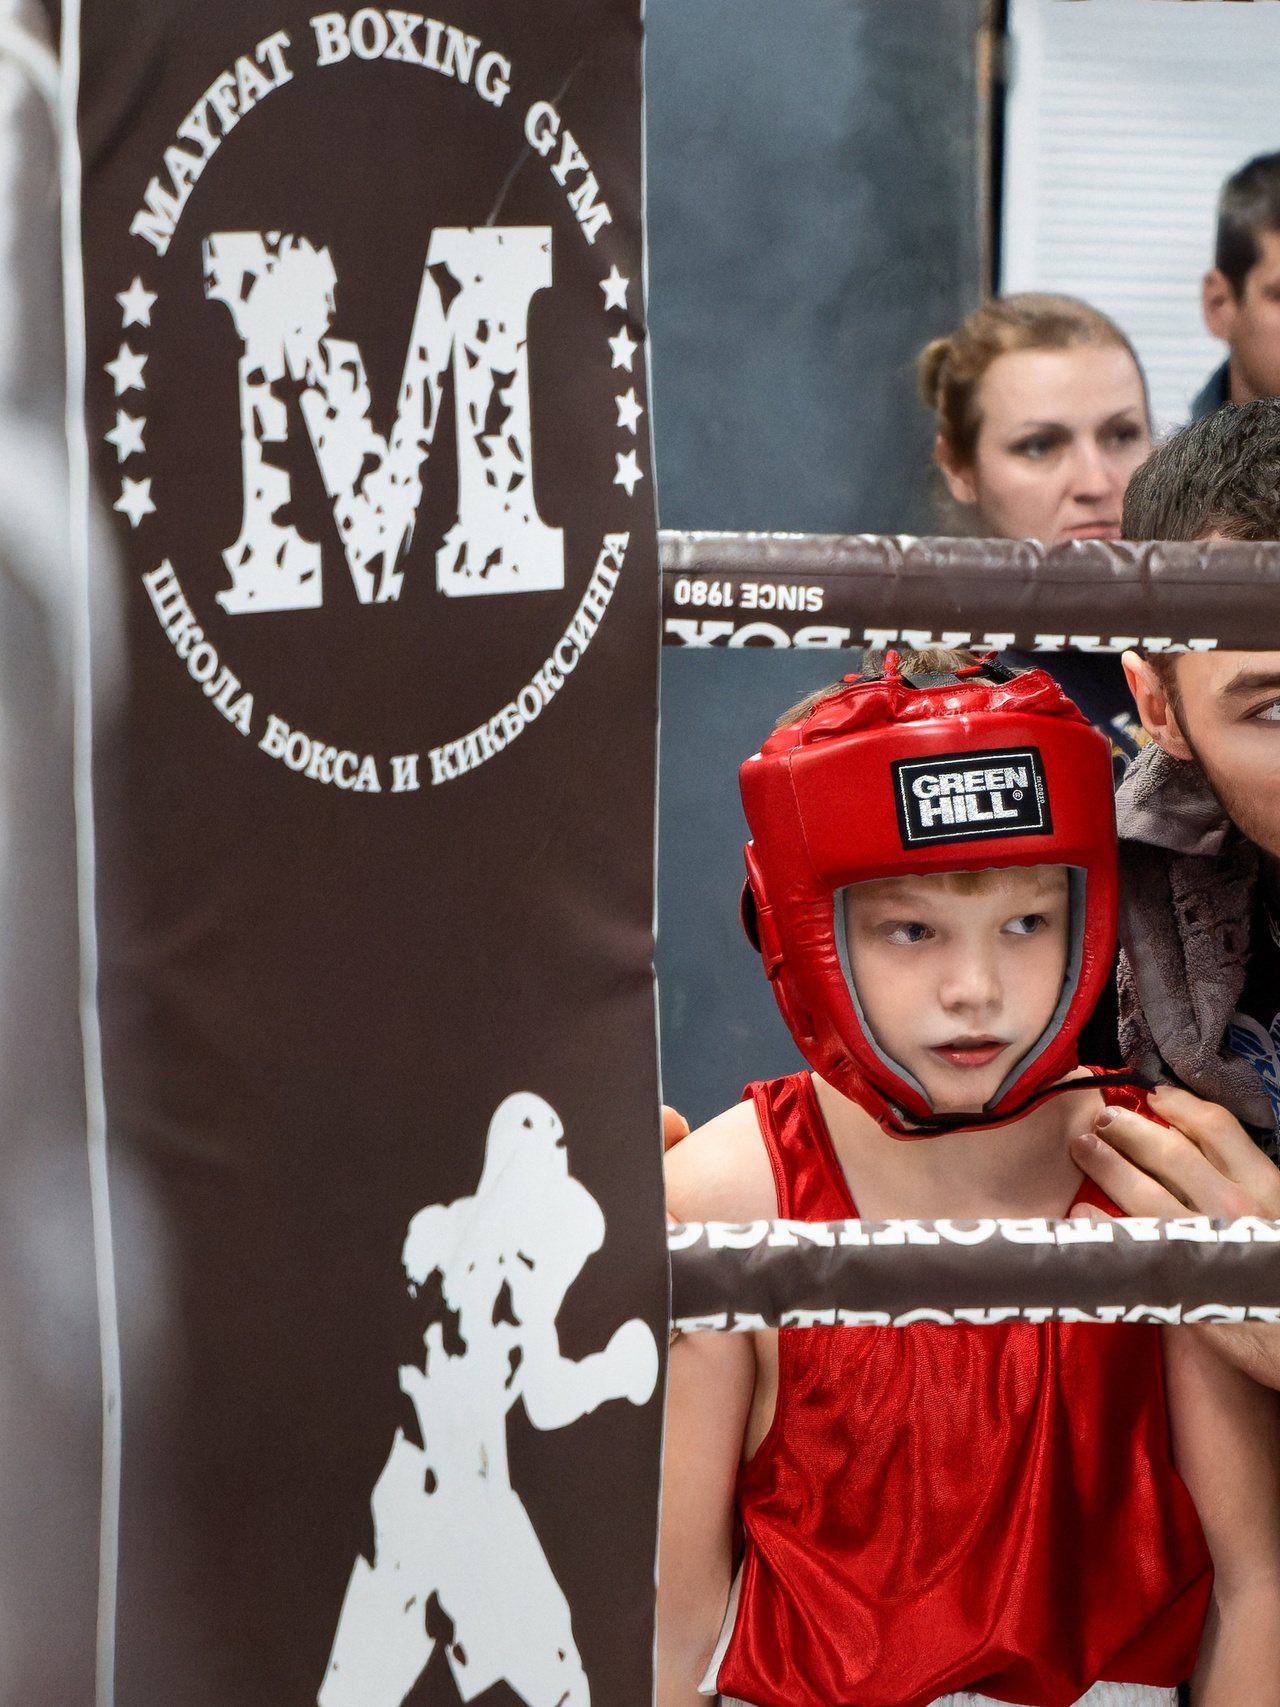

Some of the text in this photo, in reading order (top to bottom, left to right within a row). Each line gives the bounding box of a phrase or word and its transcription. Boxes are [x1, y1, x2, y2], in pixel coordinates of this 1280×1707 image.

[129, 7, 613, 257] MAYFAT BOXING GYM
[202, 226, 565, 615] M
[142, 531, 630, 793] ШКОЛА БОКСА И КИКБОКСИНГА
[673, 578, 825, 612] SINCE 1980
[911, 766, 1029, 800] GREEN
[918, 791, 1019, 828] HILL
